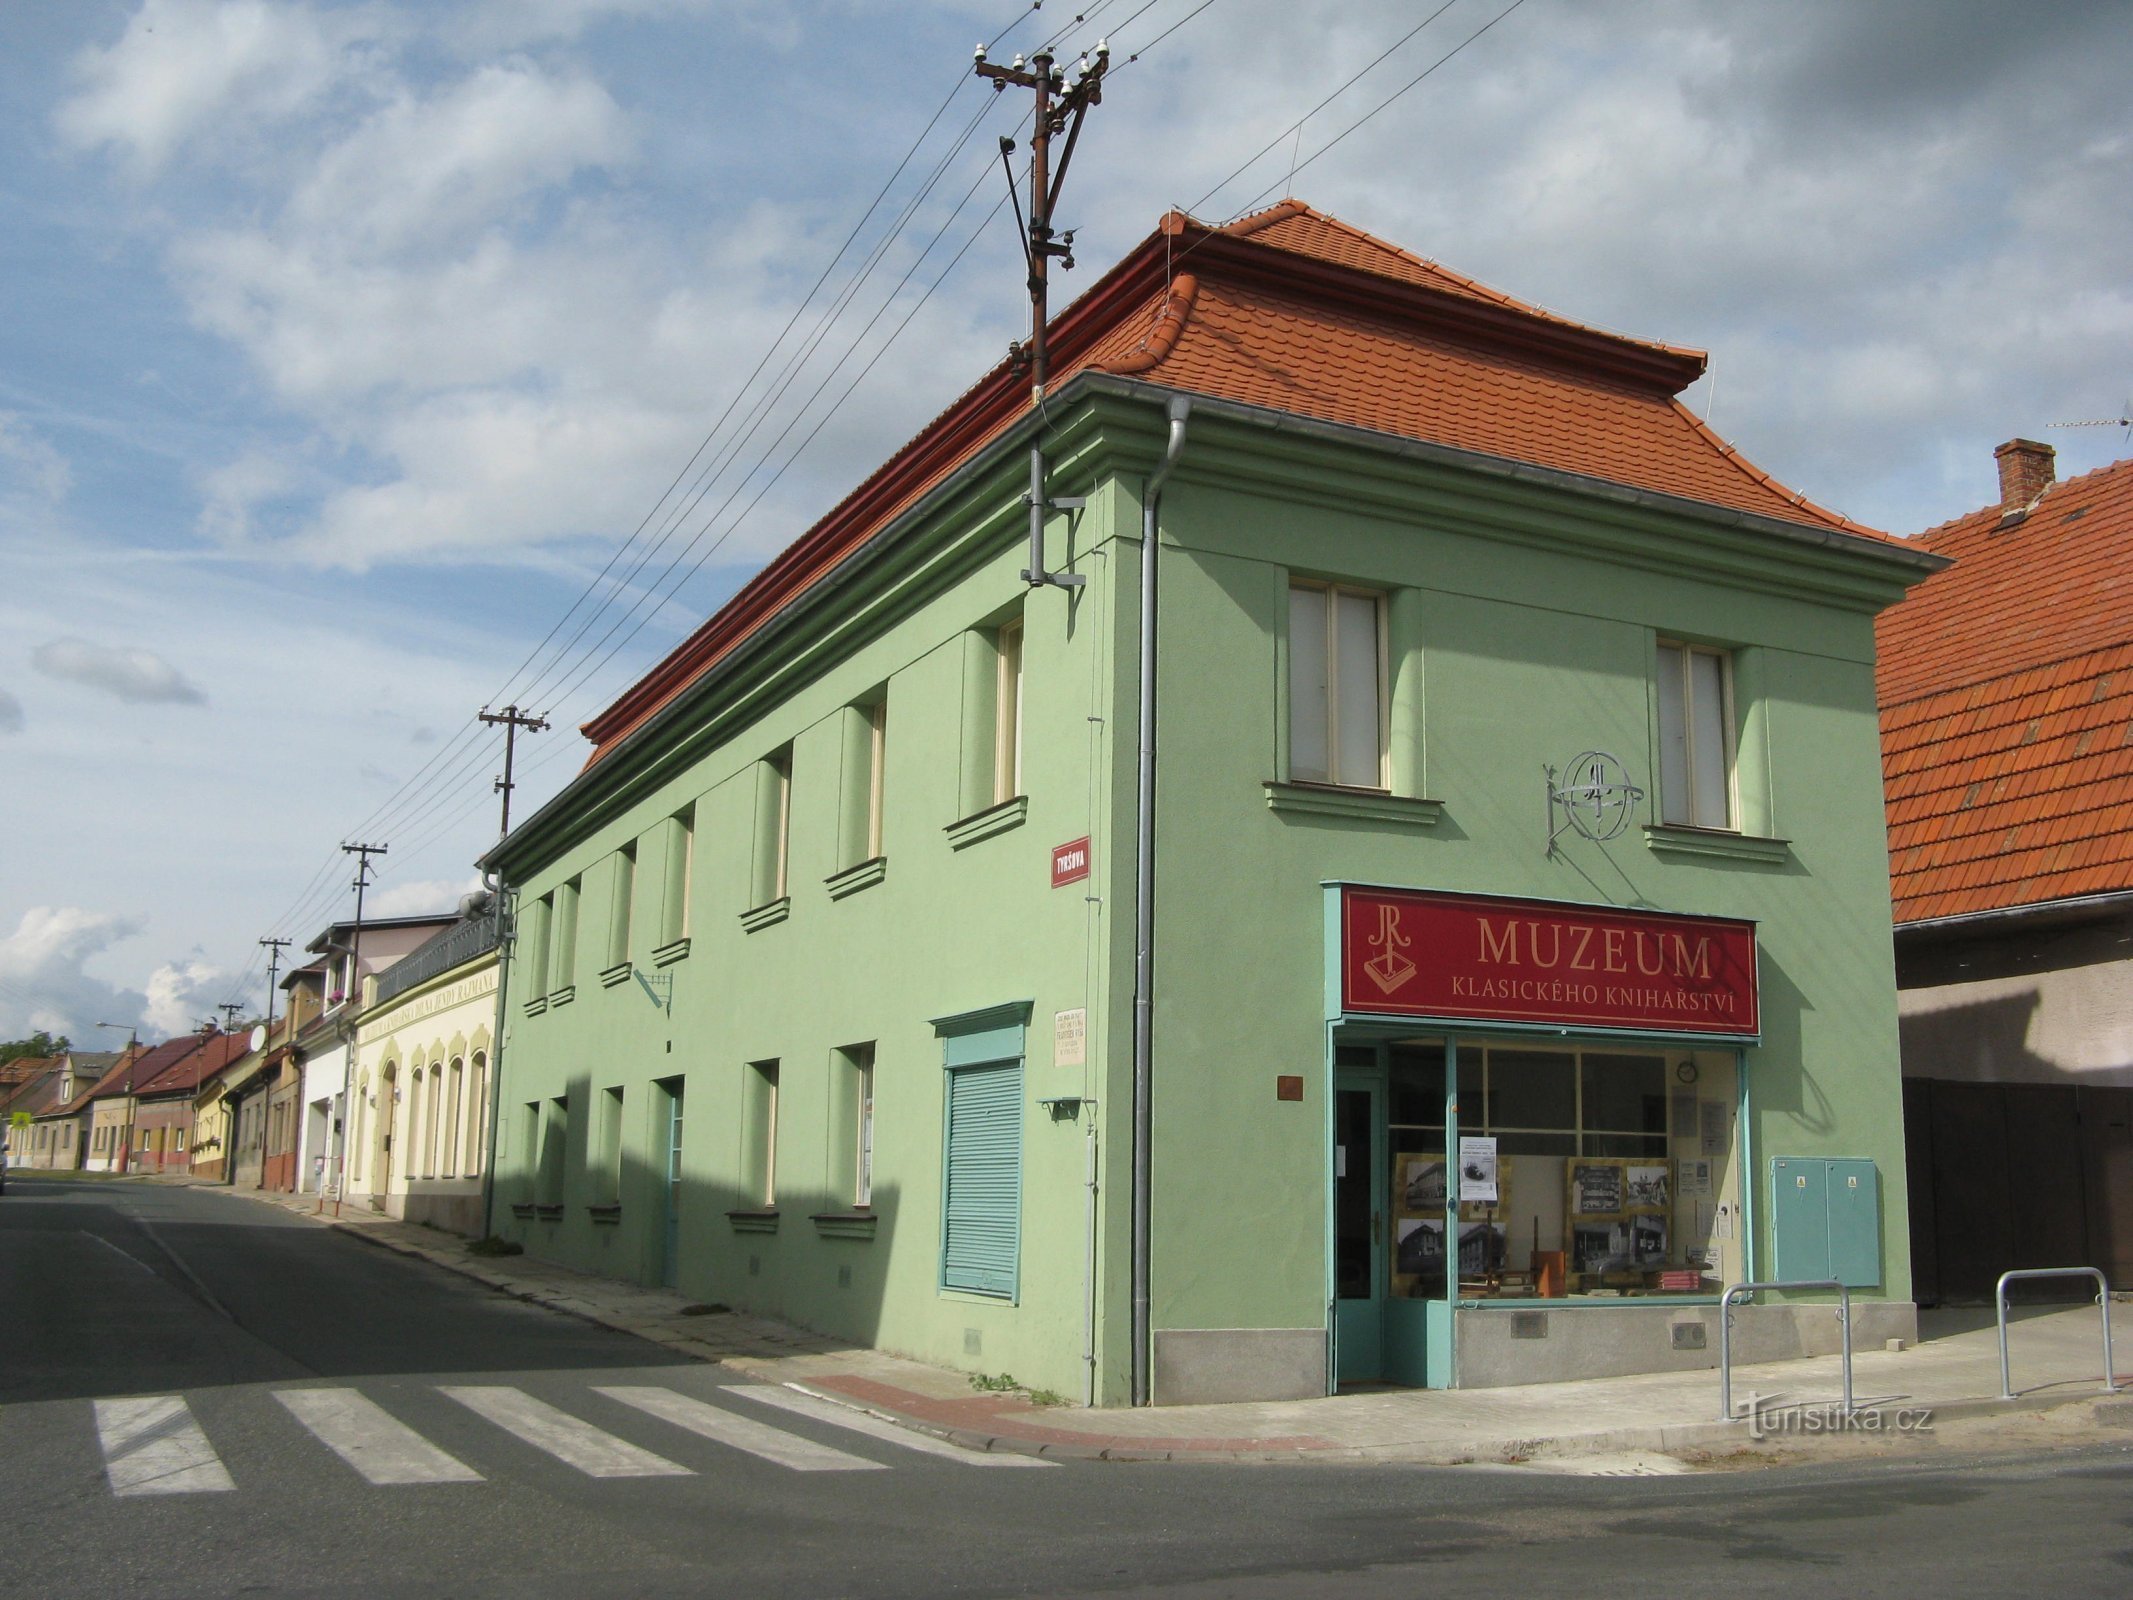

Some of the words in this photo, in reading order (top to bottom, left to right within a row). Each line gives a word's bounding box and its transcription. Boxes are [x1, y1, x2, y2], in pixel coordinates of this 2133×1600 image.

[1057, 850, 1084, 874] TYRŠOVA
[1477, 918, 1712, 979] MUZEUM
[1452, 976, 1598, 1004] KLASICKÉHO
[1606, 986, 1734, 1013] KNIHAŘSTVÍ
